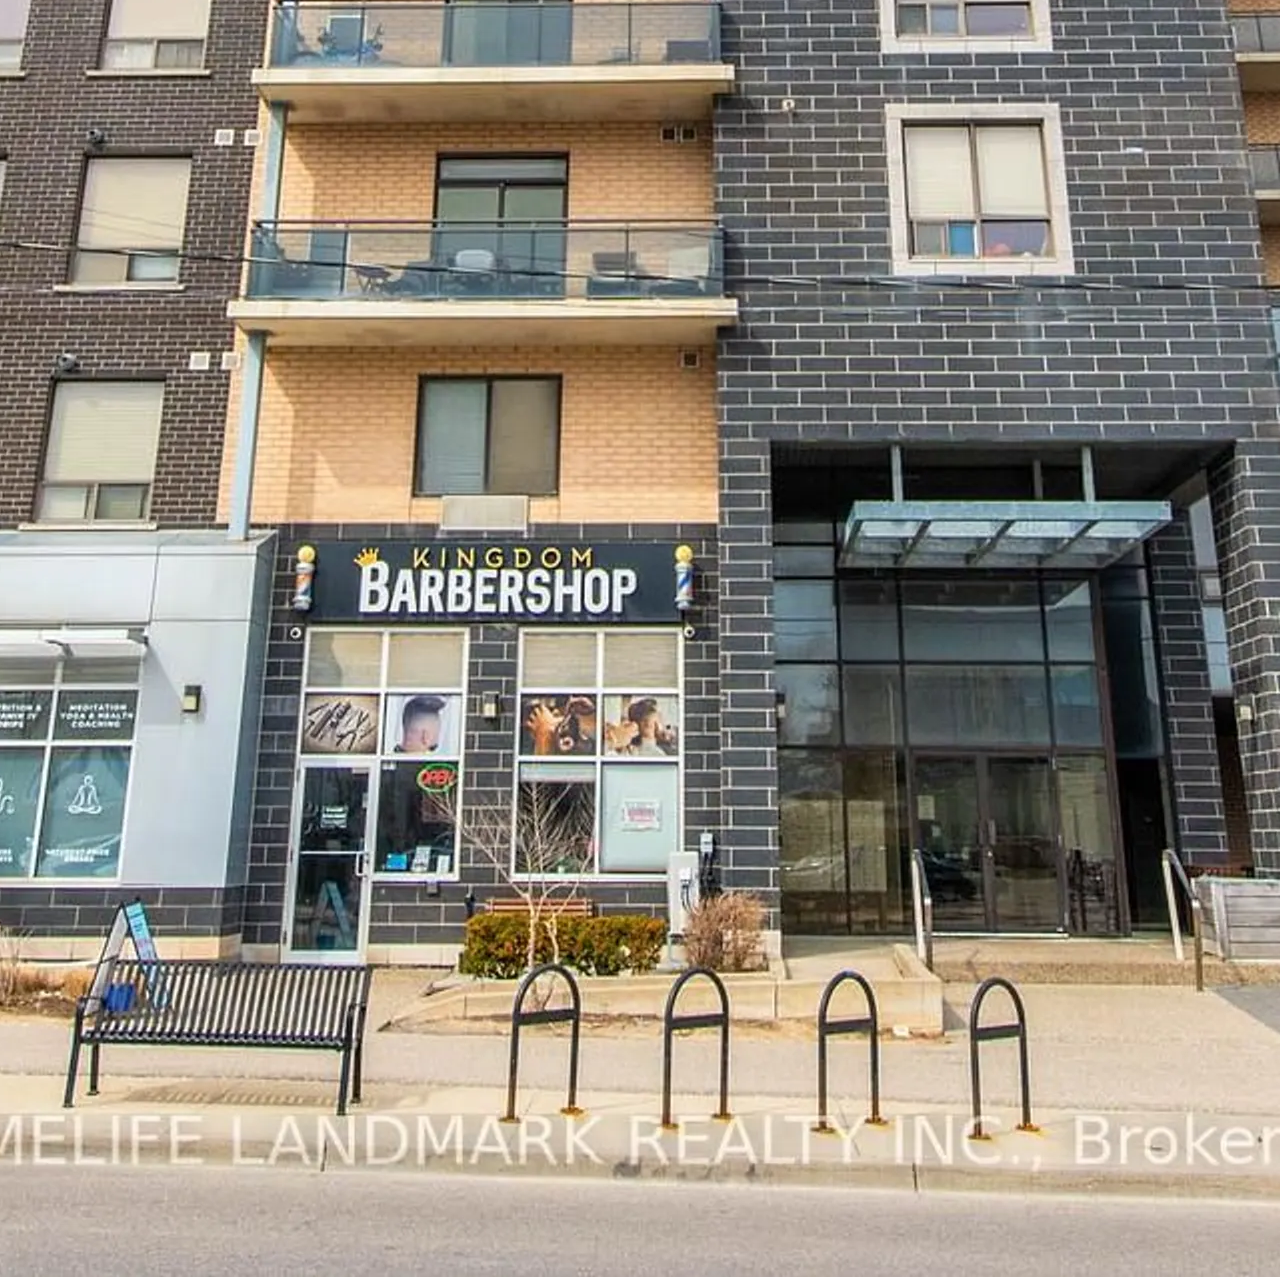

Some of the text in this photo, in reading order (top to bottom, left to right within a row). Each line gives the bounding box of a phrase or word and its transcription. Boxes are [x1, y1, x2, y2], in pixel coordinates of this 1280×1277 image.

[412, 547, 593, 569] KINGDOM
[358, 561, 638, 614] BARBERSHOP
[69, 704, 127, 712] MEDITATION
[60, 712, 86, 720] YOGA
[98, 712, 134, 720] HEALTH
